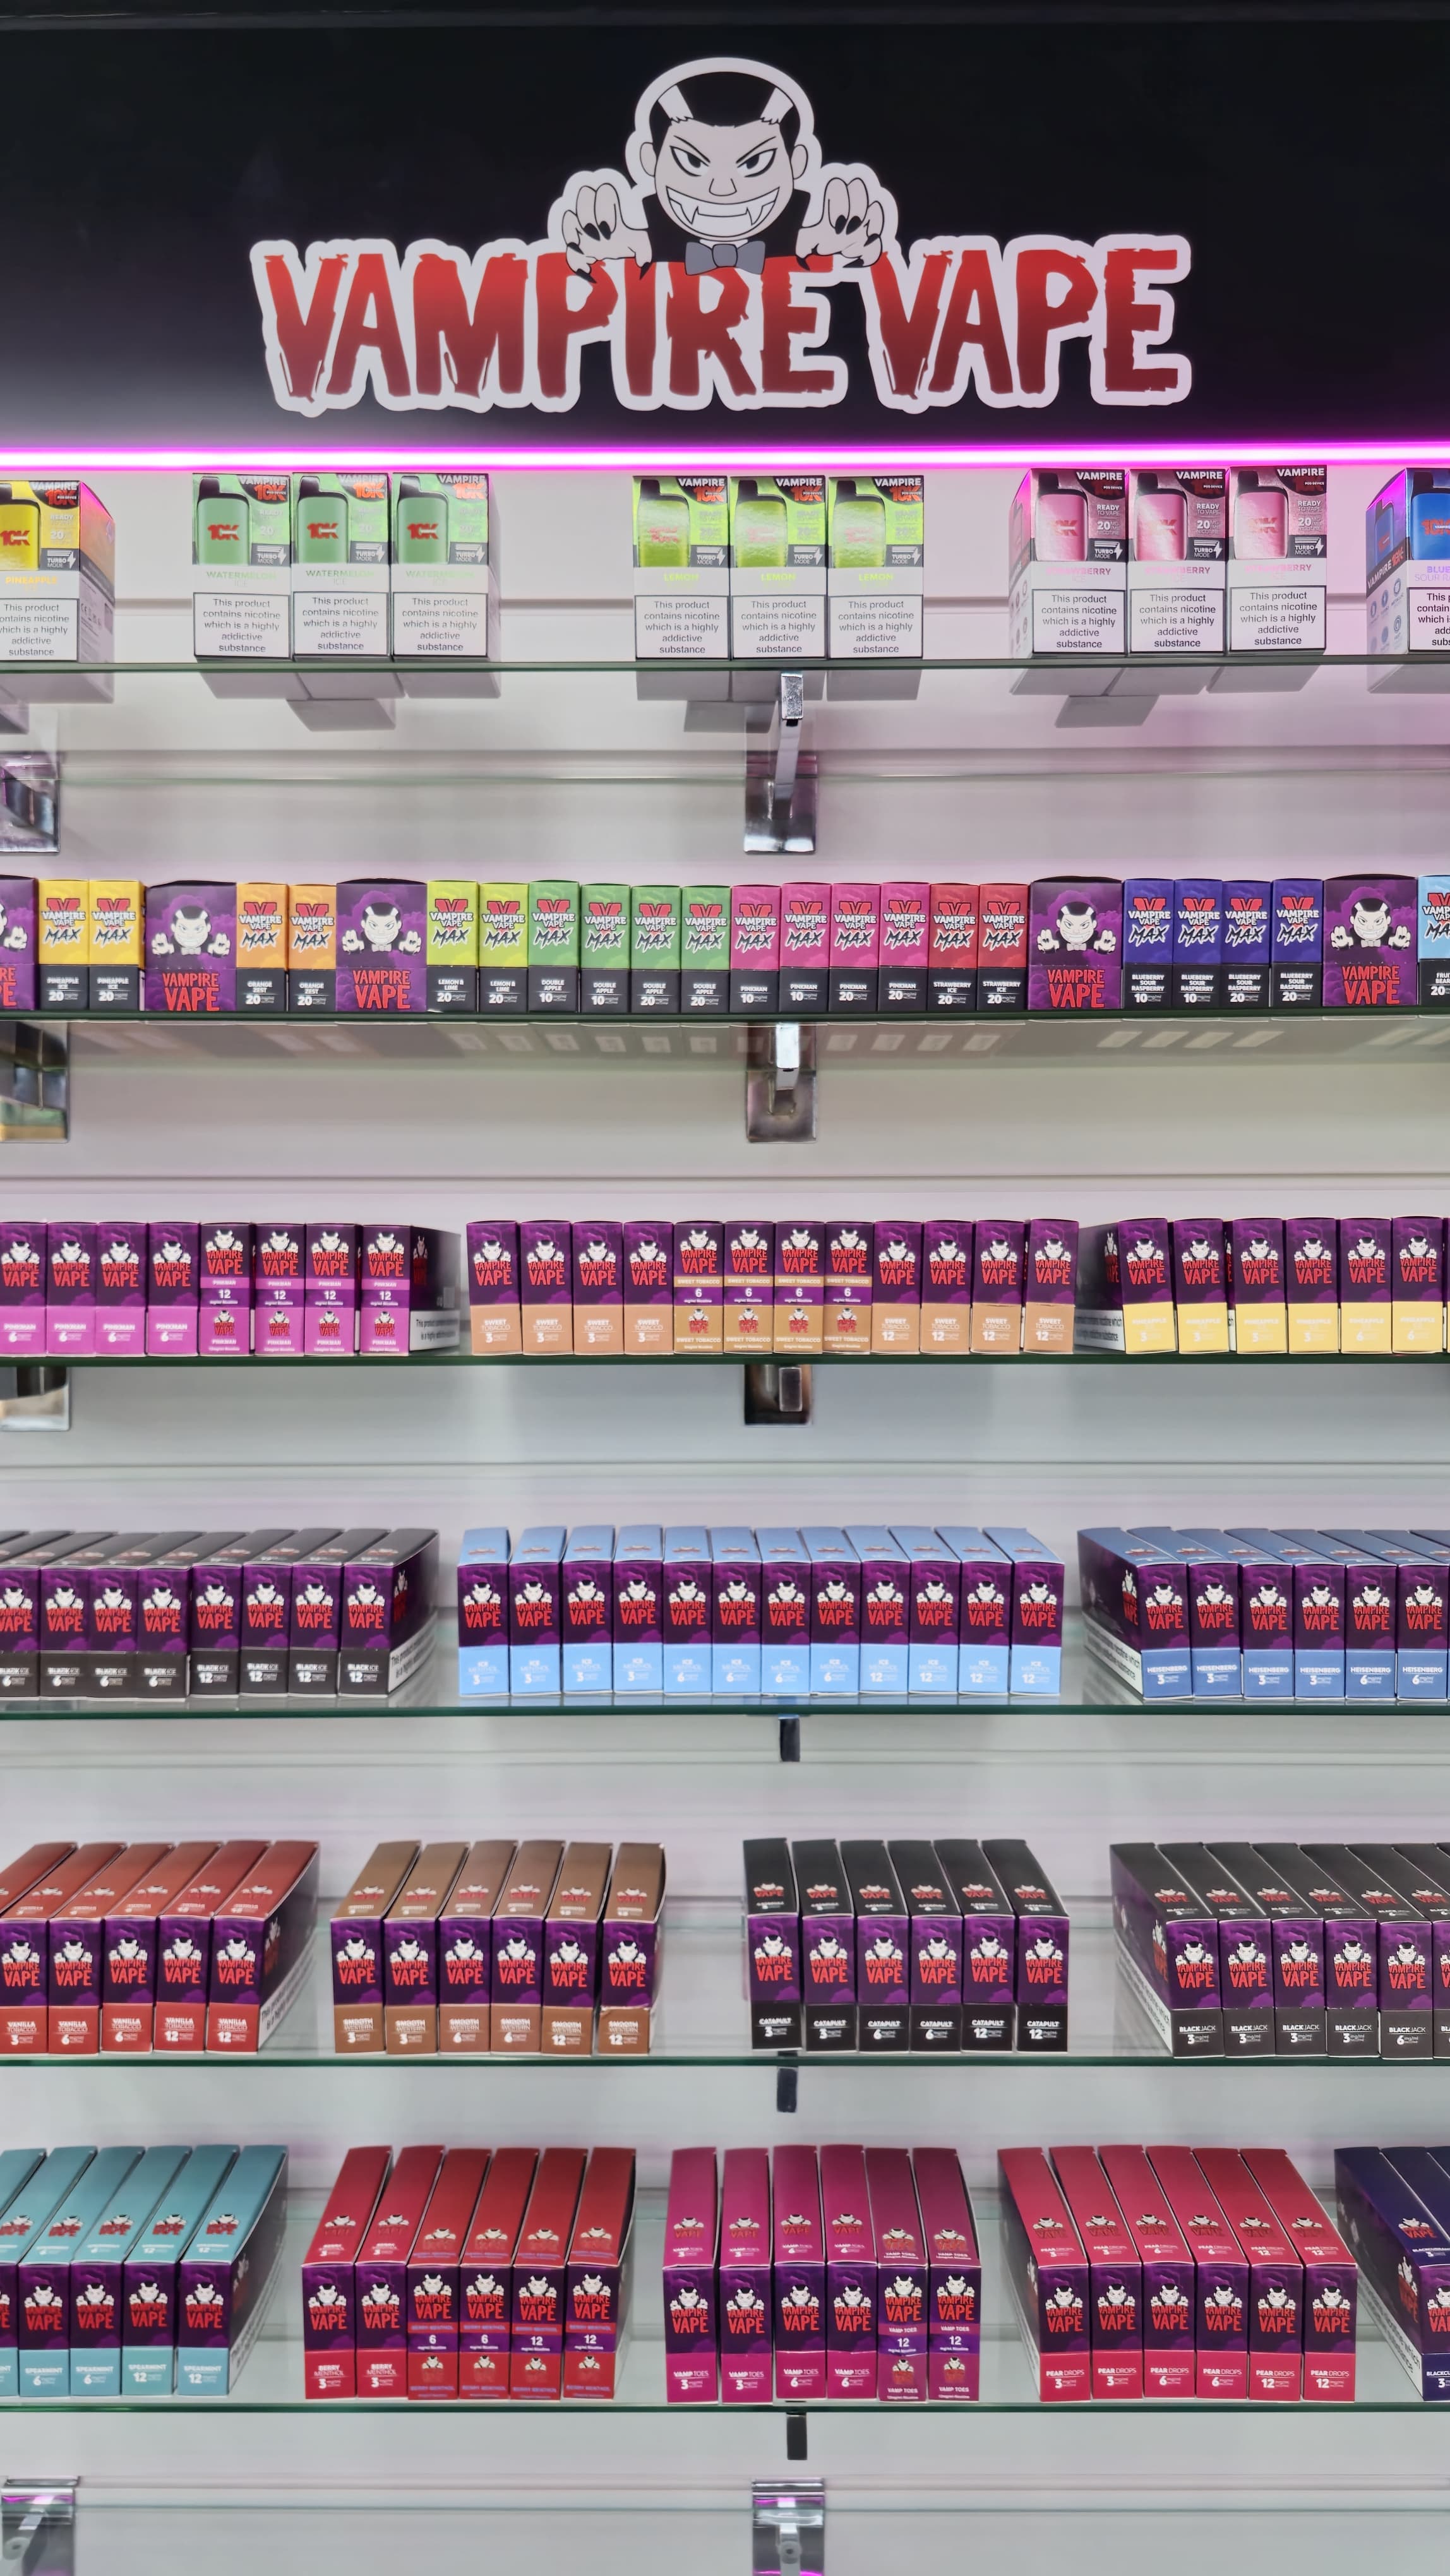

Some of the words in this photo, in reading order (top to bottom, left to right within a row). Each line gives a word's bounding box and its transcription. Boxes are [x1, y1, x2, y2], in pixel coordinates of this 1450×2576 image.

[263, 252, 836, 402] VAMPIRE
[866, 247, 1179, 402] VAPE
[1077, 472, 1122, 480] VAMPIRE
[1277, 468, 1324, 477] VAMPIRE
[1097, 522, 1110, 530] 20
[1298, 517, 1312, 526] 20
[208, 525, 239, 540] 10K
[207, 571, 277, 580] WATERMELON
[1367, 560, 1392, 589] VAMPIRE
[1052, 595, 1070, 603] This
[1073, 595, 1106, 604] product
[1272, 592, 1307, 601] product
[676, 602, 709, 610] product
[1240, 603, 1278, 611] contains
[1281, 602, 1317, 611] nicotine
[644, 612, 681, 620] contains
[1241, 614, 1267, 623] which
[1289, 614, 1315, 624] highly
[1089, 618, 1115, 628] highly
[692, 624, 718, 633] highly
[1258, 626, 1298, 634] addictive
[1254, 637, 1302, 645] substance
[430, 912, 473, 921] VAMPIRE
[1277, 910, 1319, 918] VAMPIRE
[635, 917, 676, 926] VAMPIRE
[432, 927, 470, 947] MAX
[1277, 923, 1318, 946] MAX
[635, 931, 675, 953] MAX
[934, 930, 974, 951] MAX
[353, 970, 410, 984] VAMPIRE
[1048, 970, 1105, 984] VAMPIRE
[1342, 966, 1399, 980] VAMPIRE
[162, 973, 219, 987] VAMPIRE
[1344, 981, 1399, 1004] VAPE
[1431, 986, 1445, 995] 20
[49, 992, 64, 1001] 20
[165, 987, 220, 1011] VAPE
[356, 985, 410, 1008] VAPE
[437, 993, 452, 1002] 20
[540, 993, 553, 1002] 10
[839, 993, 853, 1001] 20
[938, 996, 952, 1004] 20
[1050, 984, 1105, 1008] VAPE
[1135, 994, 1147, 1003] 10
[207, 1250, 243, 1259] VAMPIRE
[208, 1259, 243, 1274] VAPE
[1036, 1260, 1070, 1269] VAMPIRE
[1036, 1269, 1071, 1284] VAPE
[219, 1289, 231, 1298] 12
[746, 1289, 752, 1297] 6
[1036, 1332, 1048, 1340] 12
[1021, 1604, 1056, 1612] VAMPIRE
[1021, 1611, 1056, 1627] VAPE
[1148, 1614, 1183, 1629] VAPE
[349, 1672, 362, 1682] 12
[1207, 1674, 1214, 1683] 3
[1282, 1962, 1318, 1972] VAMPIRE
[219, 1969, 254, 1984] VAPE
[1028, 1968, 1062, 1984] VAPE
[1283, 1971, 1319, 1986] VAPE
[217, 2031, 231, 2042] 12
[1029, 2029, 1043, 2039] 12
[1291, 2033, 1298, 2042] 3
[469, 2303, 504, 2318] VAPE
[1313, 2308, 1350, 2317] VAMPIRE
[187, 2313, 222, 2328] VAPE
[1314, 2317, 1350, 2333] VAPE
[481, 2335, 488, 2344] 6
[949, 2336, 961, 2345] 12
[189, 2374, 202, 2383] 12
[1316, 2378, 1329, 2388] 12
